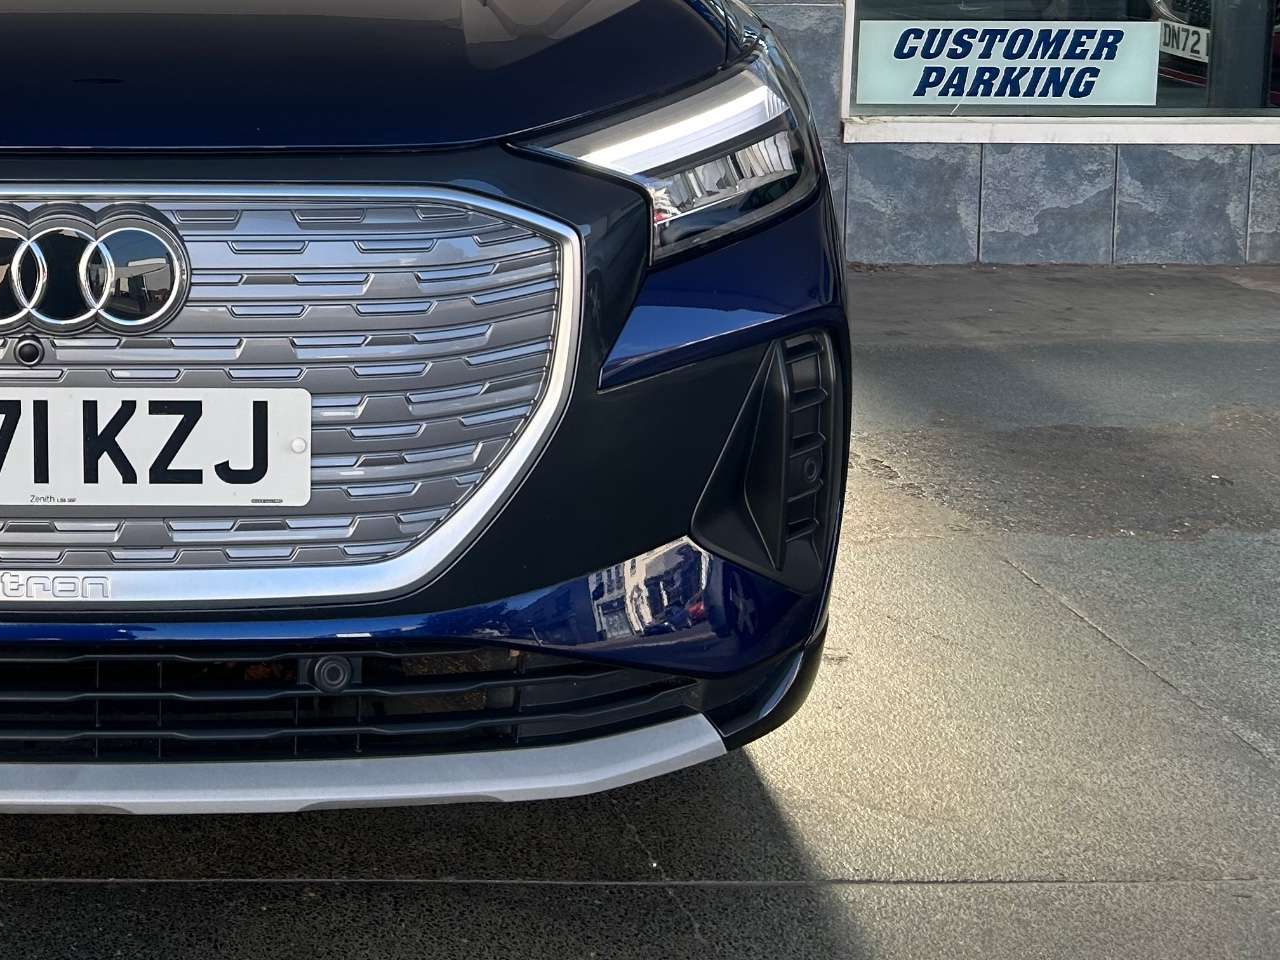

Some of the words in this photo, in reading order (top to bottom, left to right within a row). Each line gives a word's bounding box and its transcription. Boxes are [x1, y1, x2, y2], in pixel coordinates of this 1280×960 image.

[894, 27, 1125, 61] CUSTOMER
[1162, 23, 1201, 55] DN72
[913, 66, 1101, 99] PARKING
[83, 399, 269, 485] KZJ
[30, 494, 55, 503] Zenith
